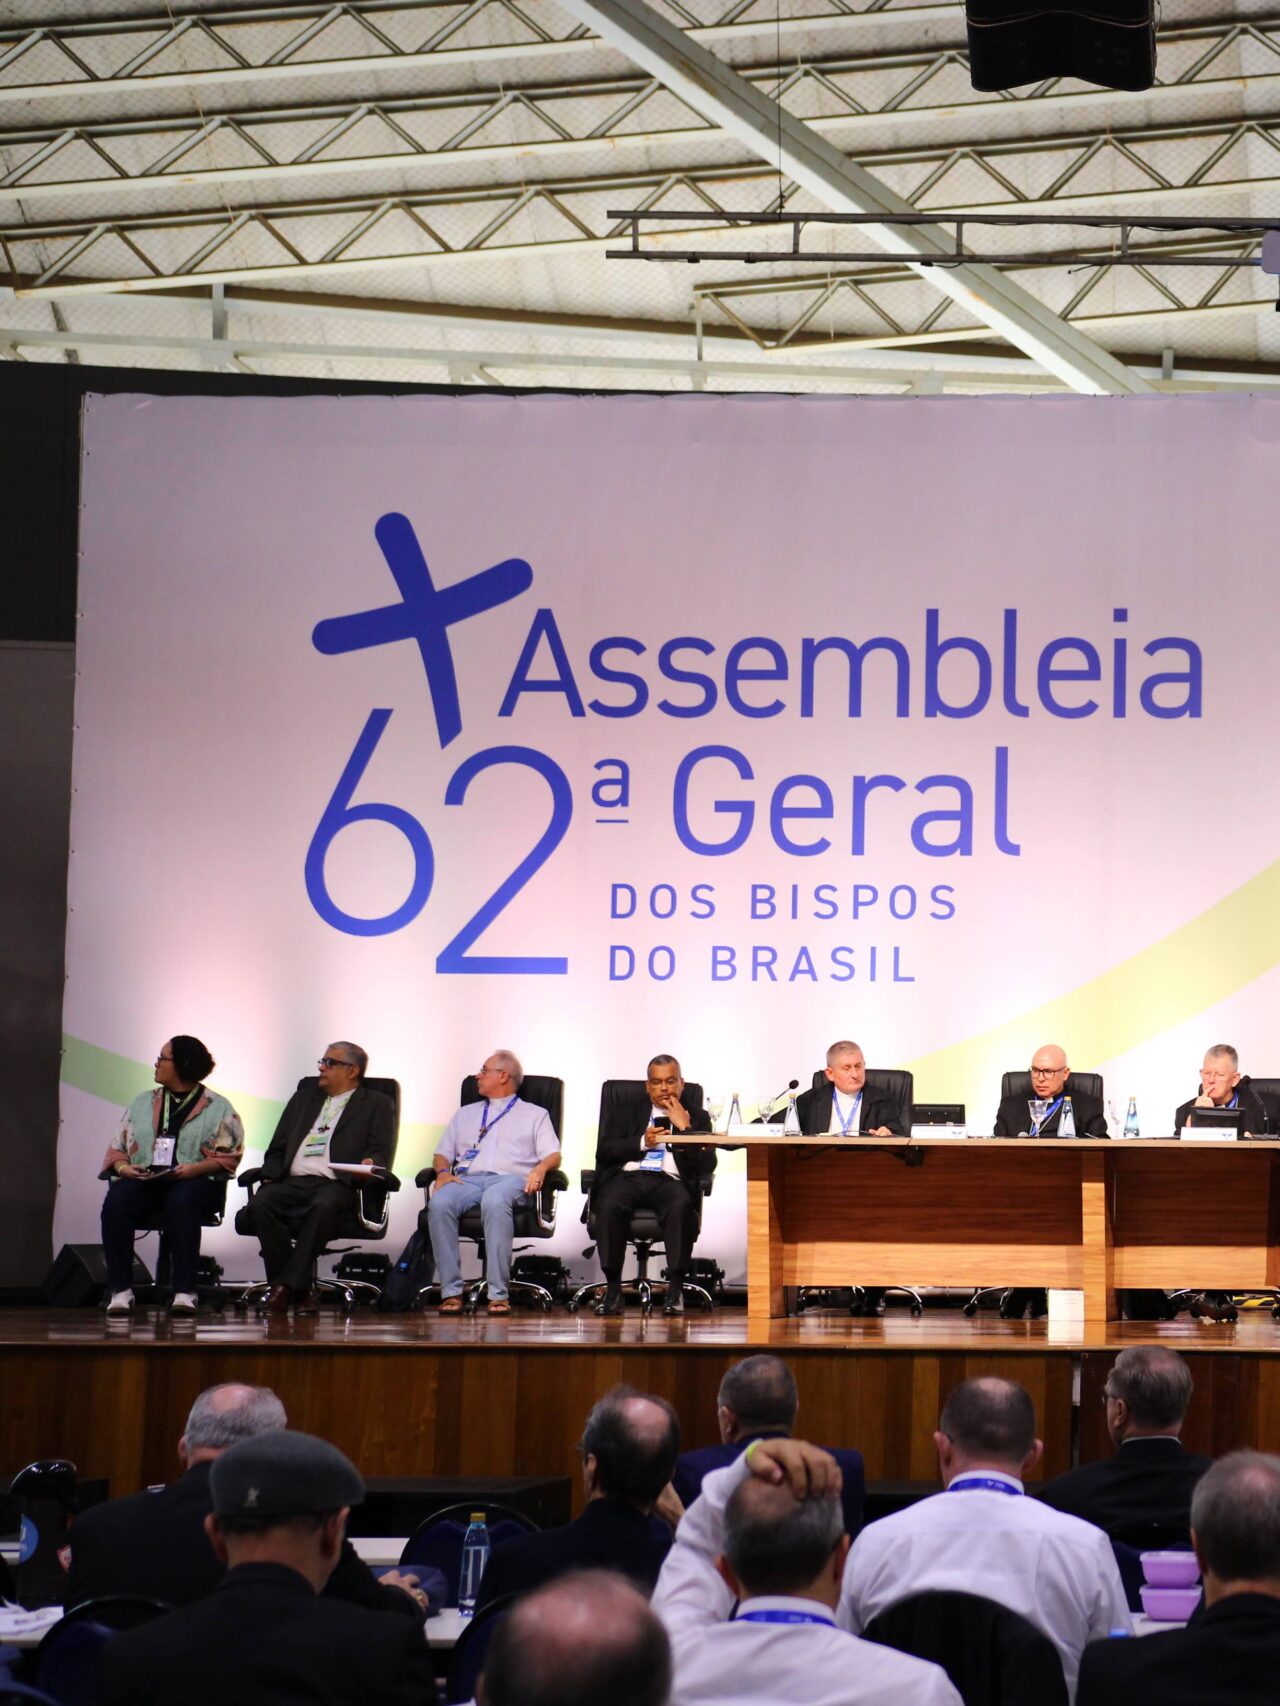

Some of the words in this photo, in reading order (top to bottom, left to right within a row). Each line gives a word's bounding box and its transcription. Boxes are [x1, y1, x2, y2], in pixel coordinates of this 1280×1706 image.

[497, 606, 1204, 720] Assembleia
[673, 745, 1022, 857] Geral
[608, 883, 716, 920] DOS
[750, 883, 957, 920] BISPOS
[608, 945, 676, 982] DO
[711, 945, 916, 982] BRASIL
